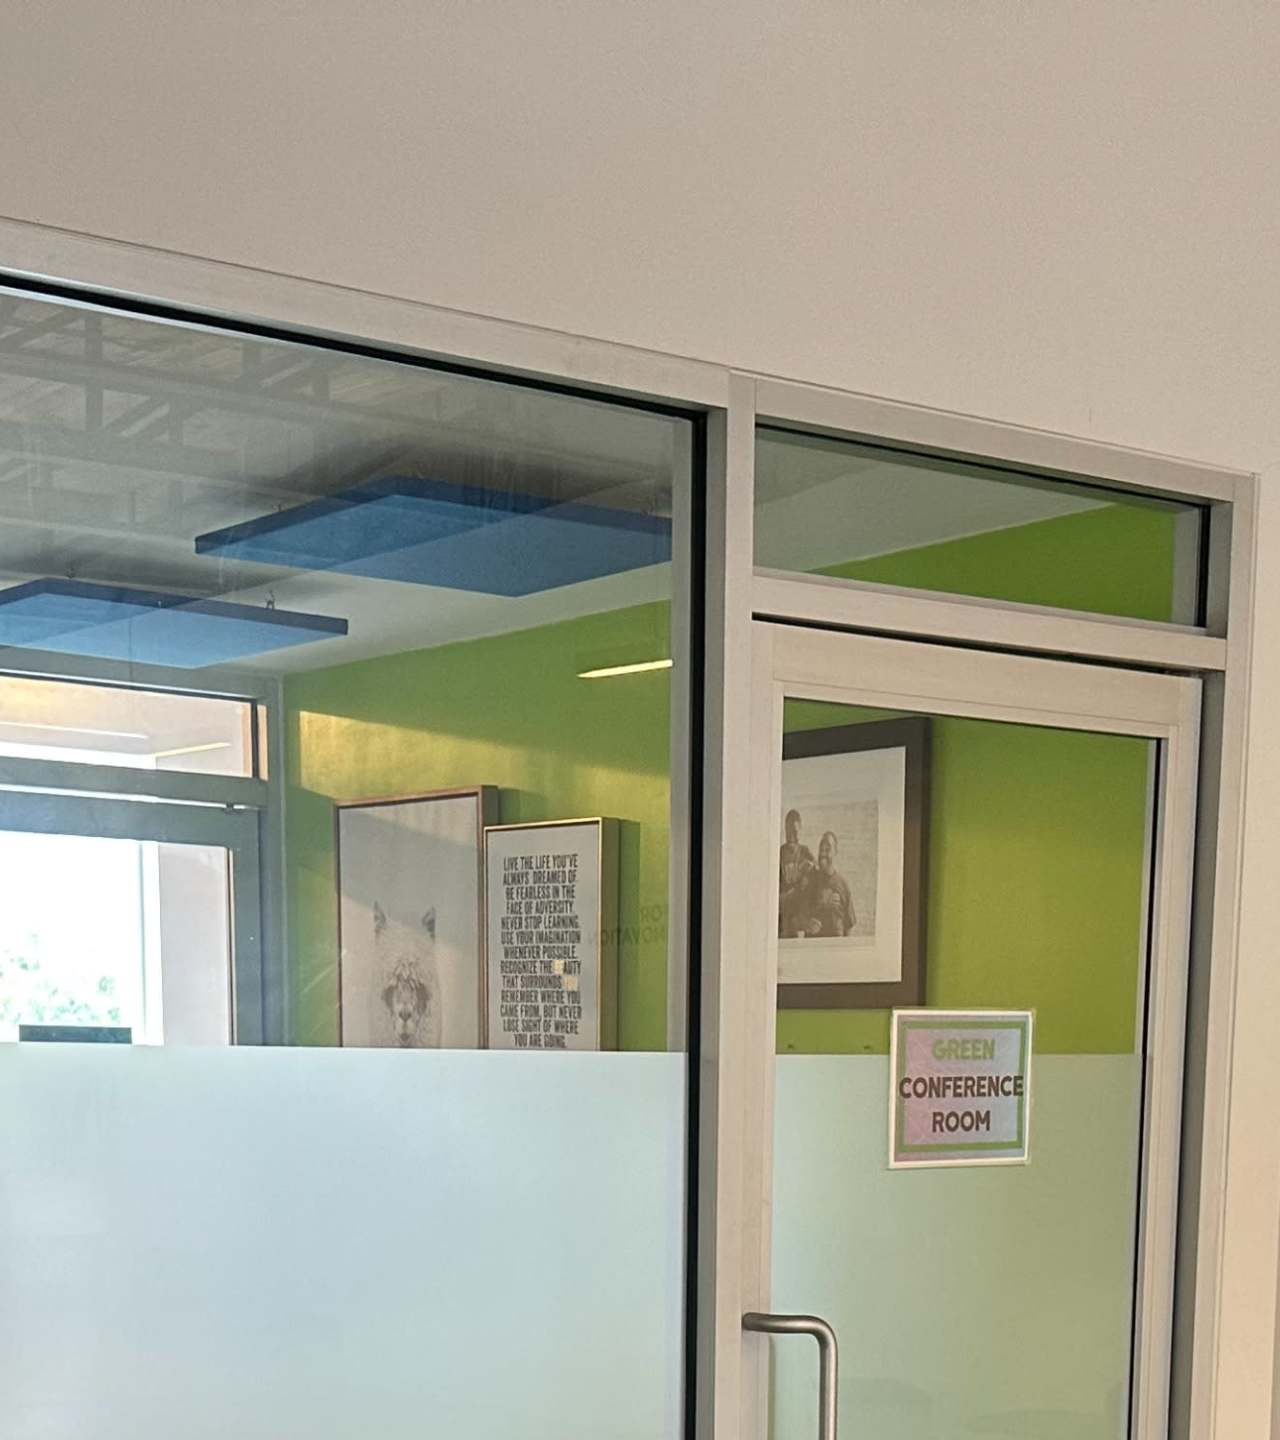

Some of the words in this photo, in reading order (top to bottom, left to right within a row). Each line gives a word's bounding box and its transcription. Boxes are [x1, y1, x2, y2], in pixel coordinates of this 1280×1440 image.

[504, 856, 519, 871] LIVE
[521, 856, 533, 870] THE
[536, 855, 550, 869] LIFE
[503, 871, 529, 886] ALWAYS
[533, 870, 566, 884] DREAMED
[506, 887, 514, 900] BE
[516, 886, 550, 900] FEARLESS
[552, 885, 560, 899] IN
[562, 884, 575, 898] THE
[506, 901, 522, 914] FACE
[524, 901, 533, 914] OF
[501, 916, 523, 930] NEVER
[524, 916, 542, 929] STOP
[501, 931, 514, 945] USE
[516, 931, 533, 944] YOUR
[535, 930, 581, 944] IMAGINATION
[504, 946, 540, 959] WHENEVER
[500, 960, 537, 974] RECOGNIZE
[540, 961, 552, 974] THE
[554, 960, 581, 975] AUTY
[503, 975, 519, 988] THAT
[520, 975, 561, 989] SURROUNDS
[501, 990, 538, 1003] REMEMBER
[540, 990, 565, 1004] WHERE
[567, 991, 581, 1004] YOU
[500, 1004, 519, 1017] CAME
[543, 1005, 557, 1018] BUT
[559, 1005, 581, 1019] NEVER
[503, 1019, 519, 1032] LOSE
[521, 1019, 541, 1032] SIGHT
[543, 1019, 551, 1032] OF
[554, 1020, 578, 1034] WHERE
[514, 1034, 528, 1047] YOU
[529, 1034, 542, 1047] ARE
[933, 1038, 995, 1060] GREEN
[899, 1075, 1024, 1099] CONFERENCE
[931, 1110, 991, 1133] ROOM
